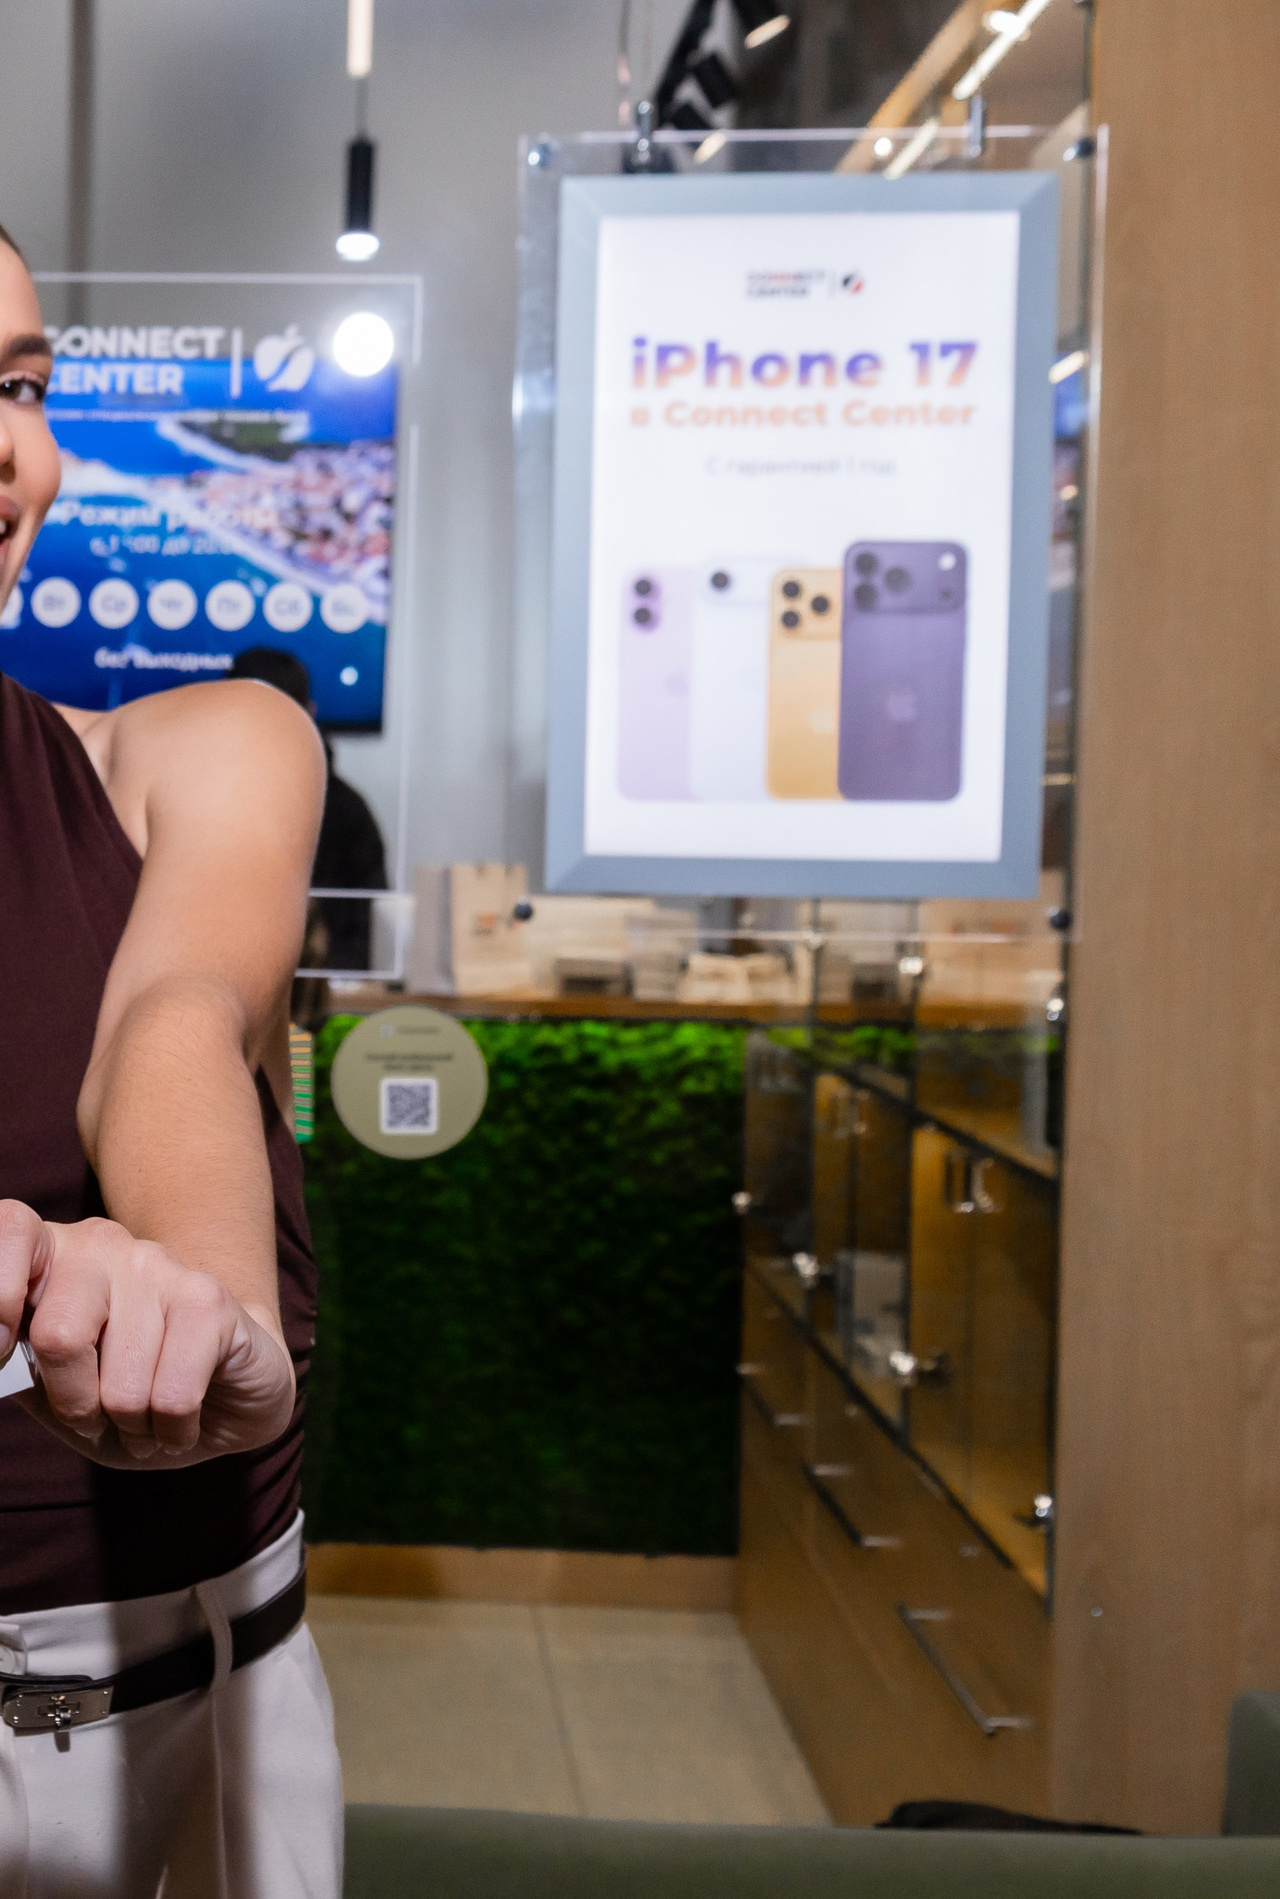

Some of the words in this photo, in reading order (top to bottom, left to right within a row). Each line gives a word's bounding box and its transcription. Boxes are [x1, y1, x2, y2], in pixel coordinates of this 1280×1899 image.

[632, 336, 883, 388] iPhone
[908, 341, 978, 388] 17
[664, 401, 827, 427] Connect
[842, 401, 976, 426] Center
